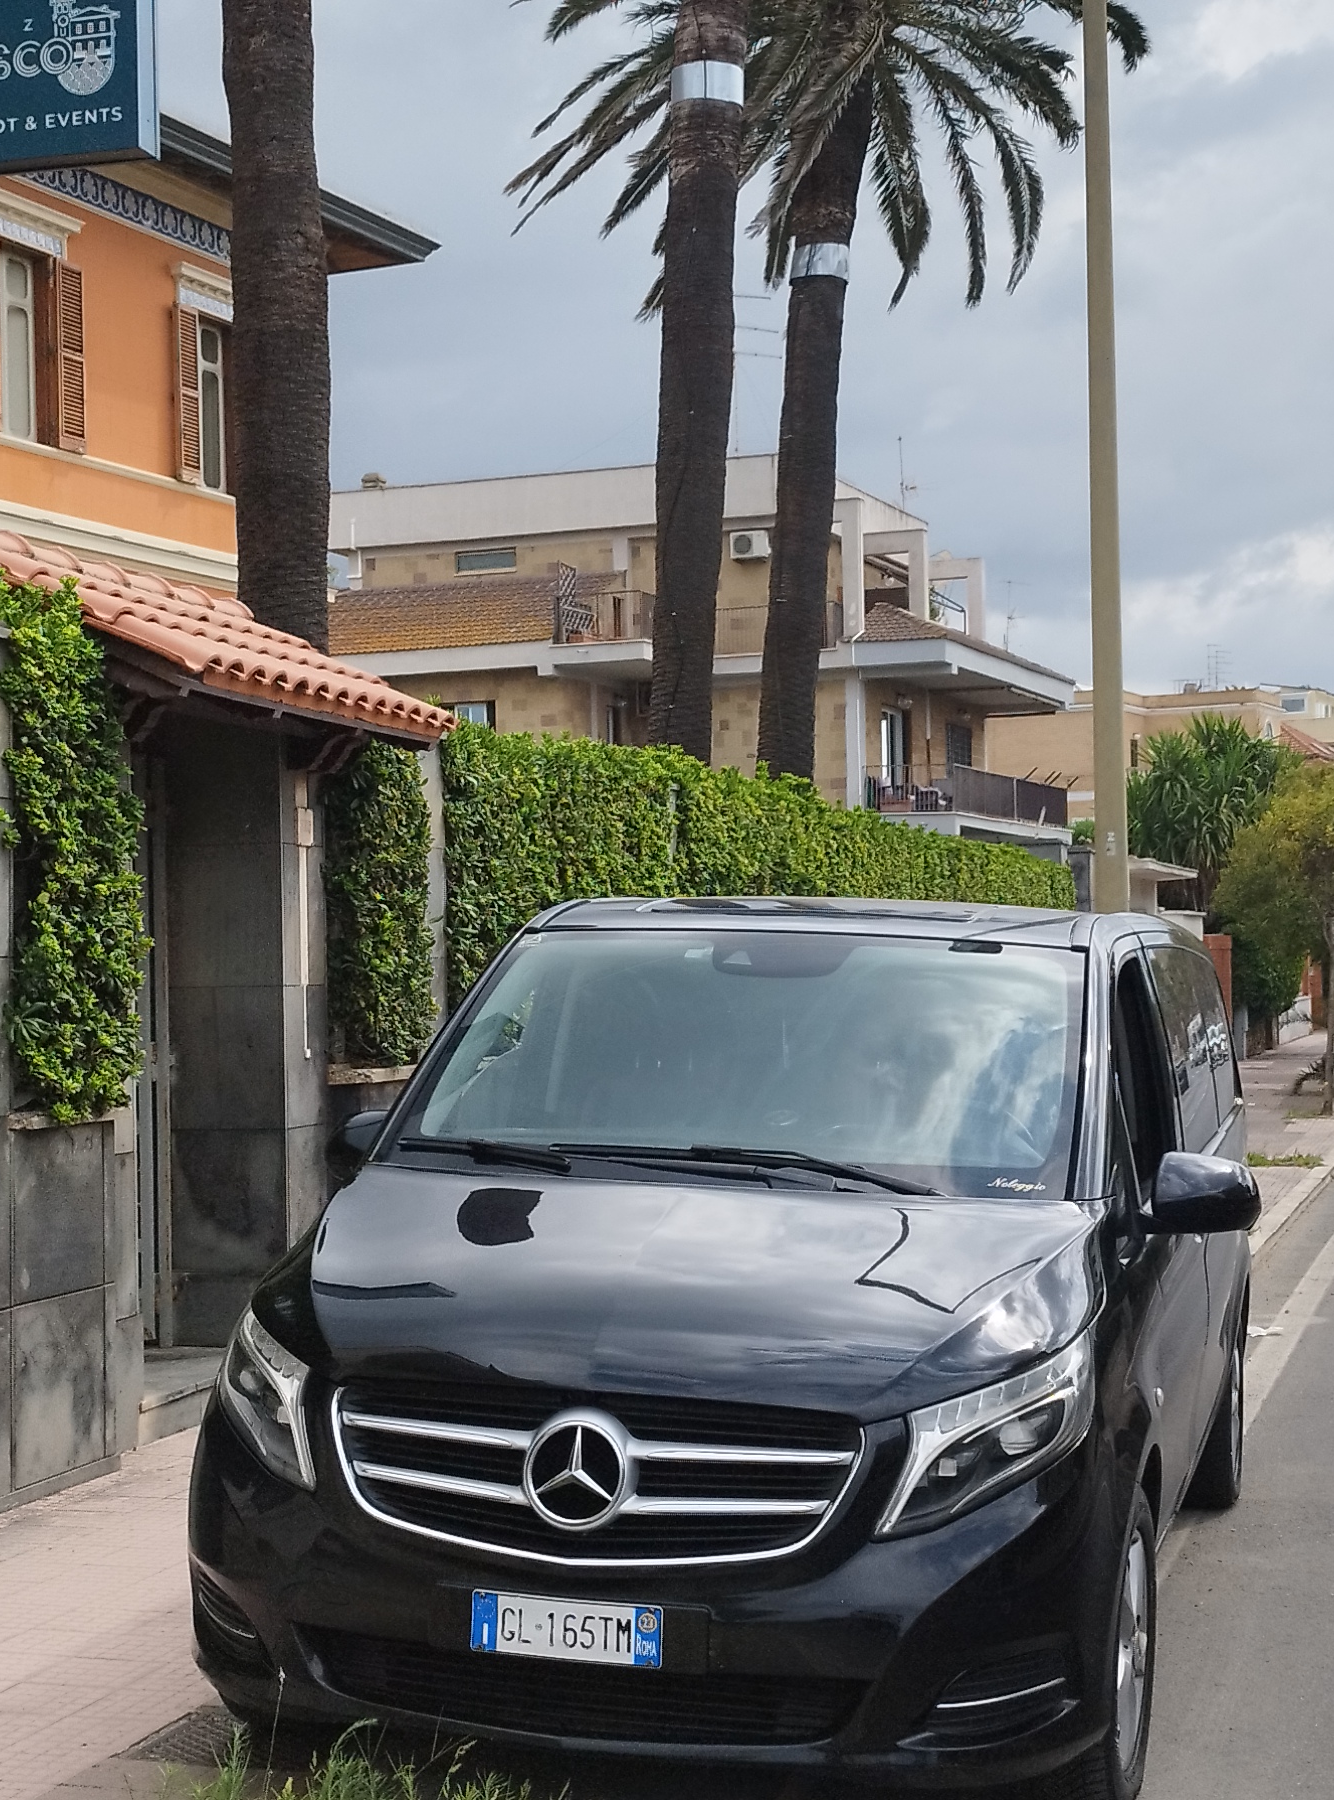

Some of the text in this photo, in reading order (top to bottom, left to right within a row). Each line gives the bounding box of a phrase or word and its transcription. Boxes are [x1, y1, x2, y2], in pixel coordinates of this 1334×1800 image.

[24, 115, 38, 131] &
[45, 106, 123, 129] EVENTS
[986, 1176, 1046, 1193] Noleggio
